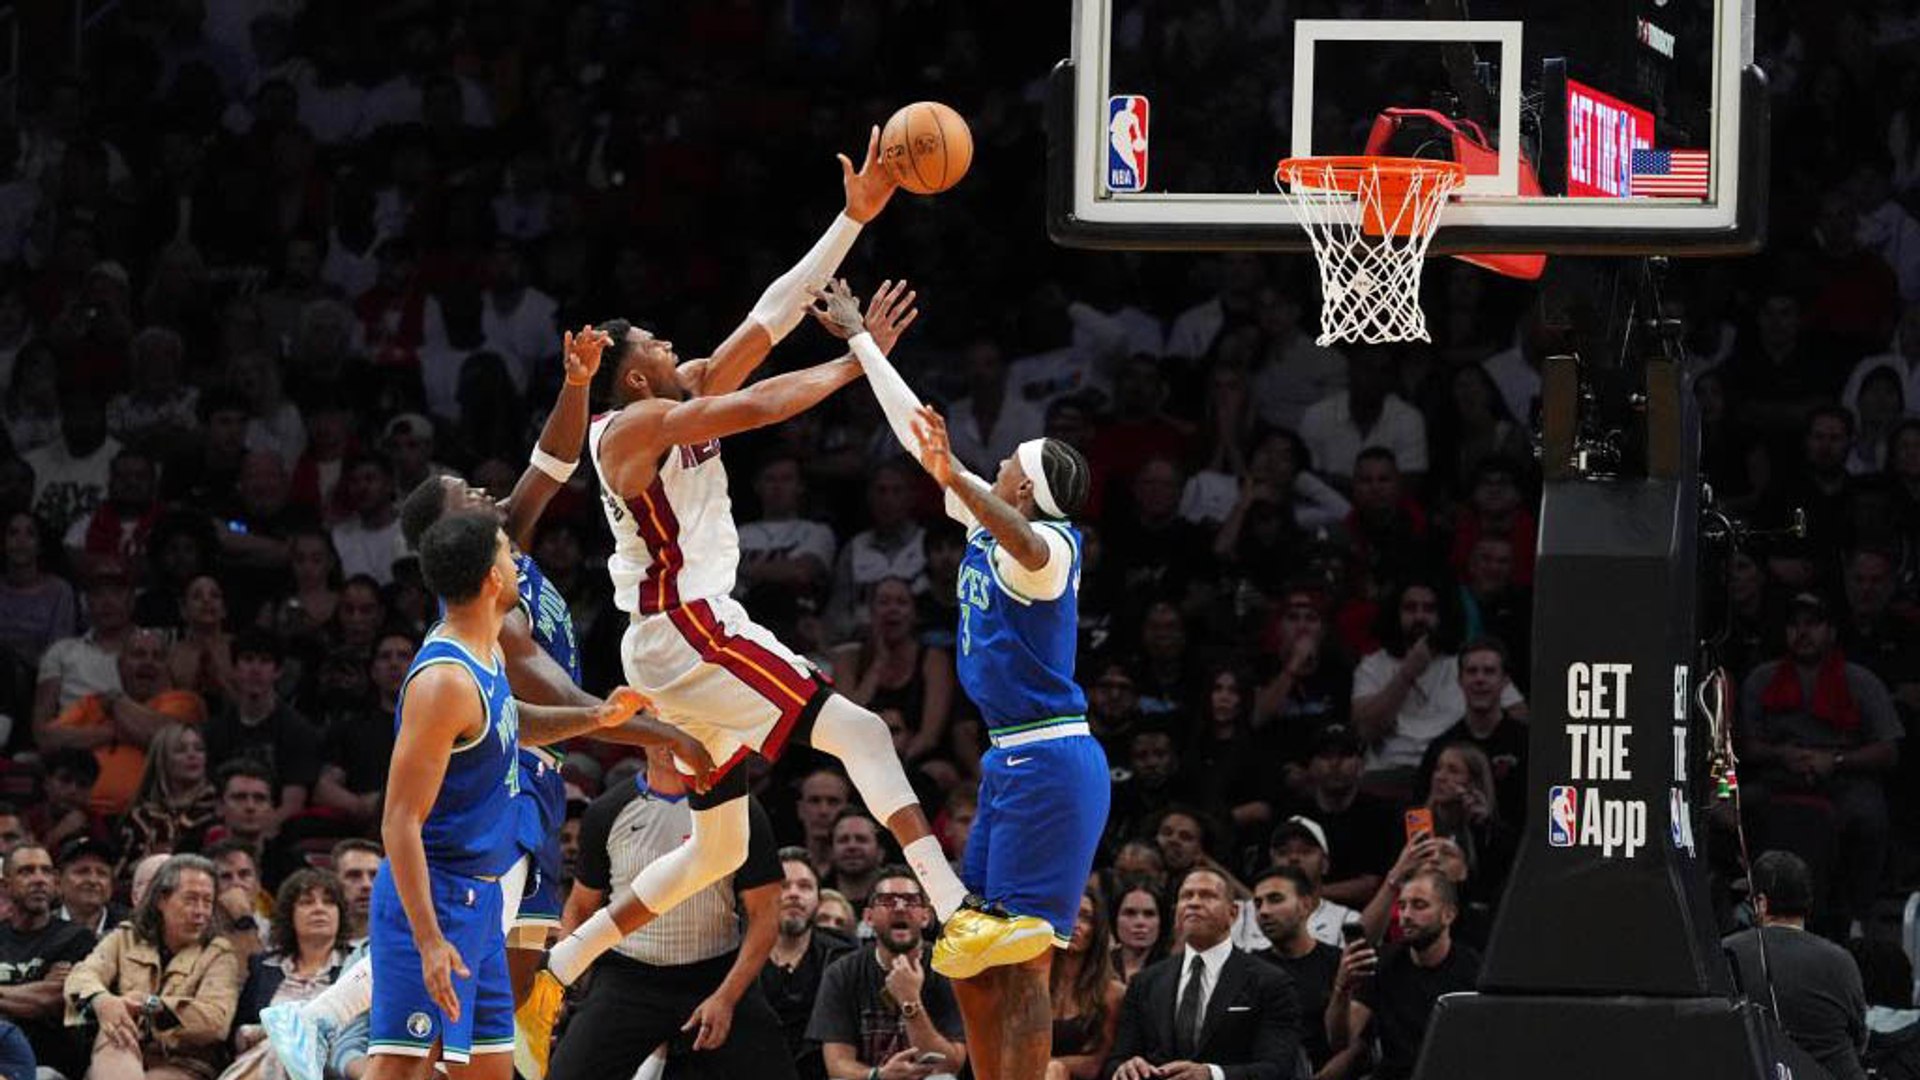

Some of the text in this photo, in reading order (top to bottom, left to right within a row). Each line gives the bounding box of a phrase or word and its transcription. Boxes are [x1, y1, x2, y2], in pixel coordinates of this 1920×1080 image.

[1571, 91, 1618, 195] GET THE
[1112, 169, 1132, 185] NBA
[1568, 662, 1632, 719] GET
[1566, 725, 1632, 779] THE
[1580, 788, 1647, 858] App
